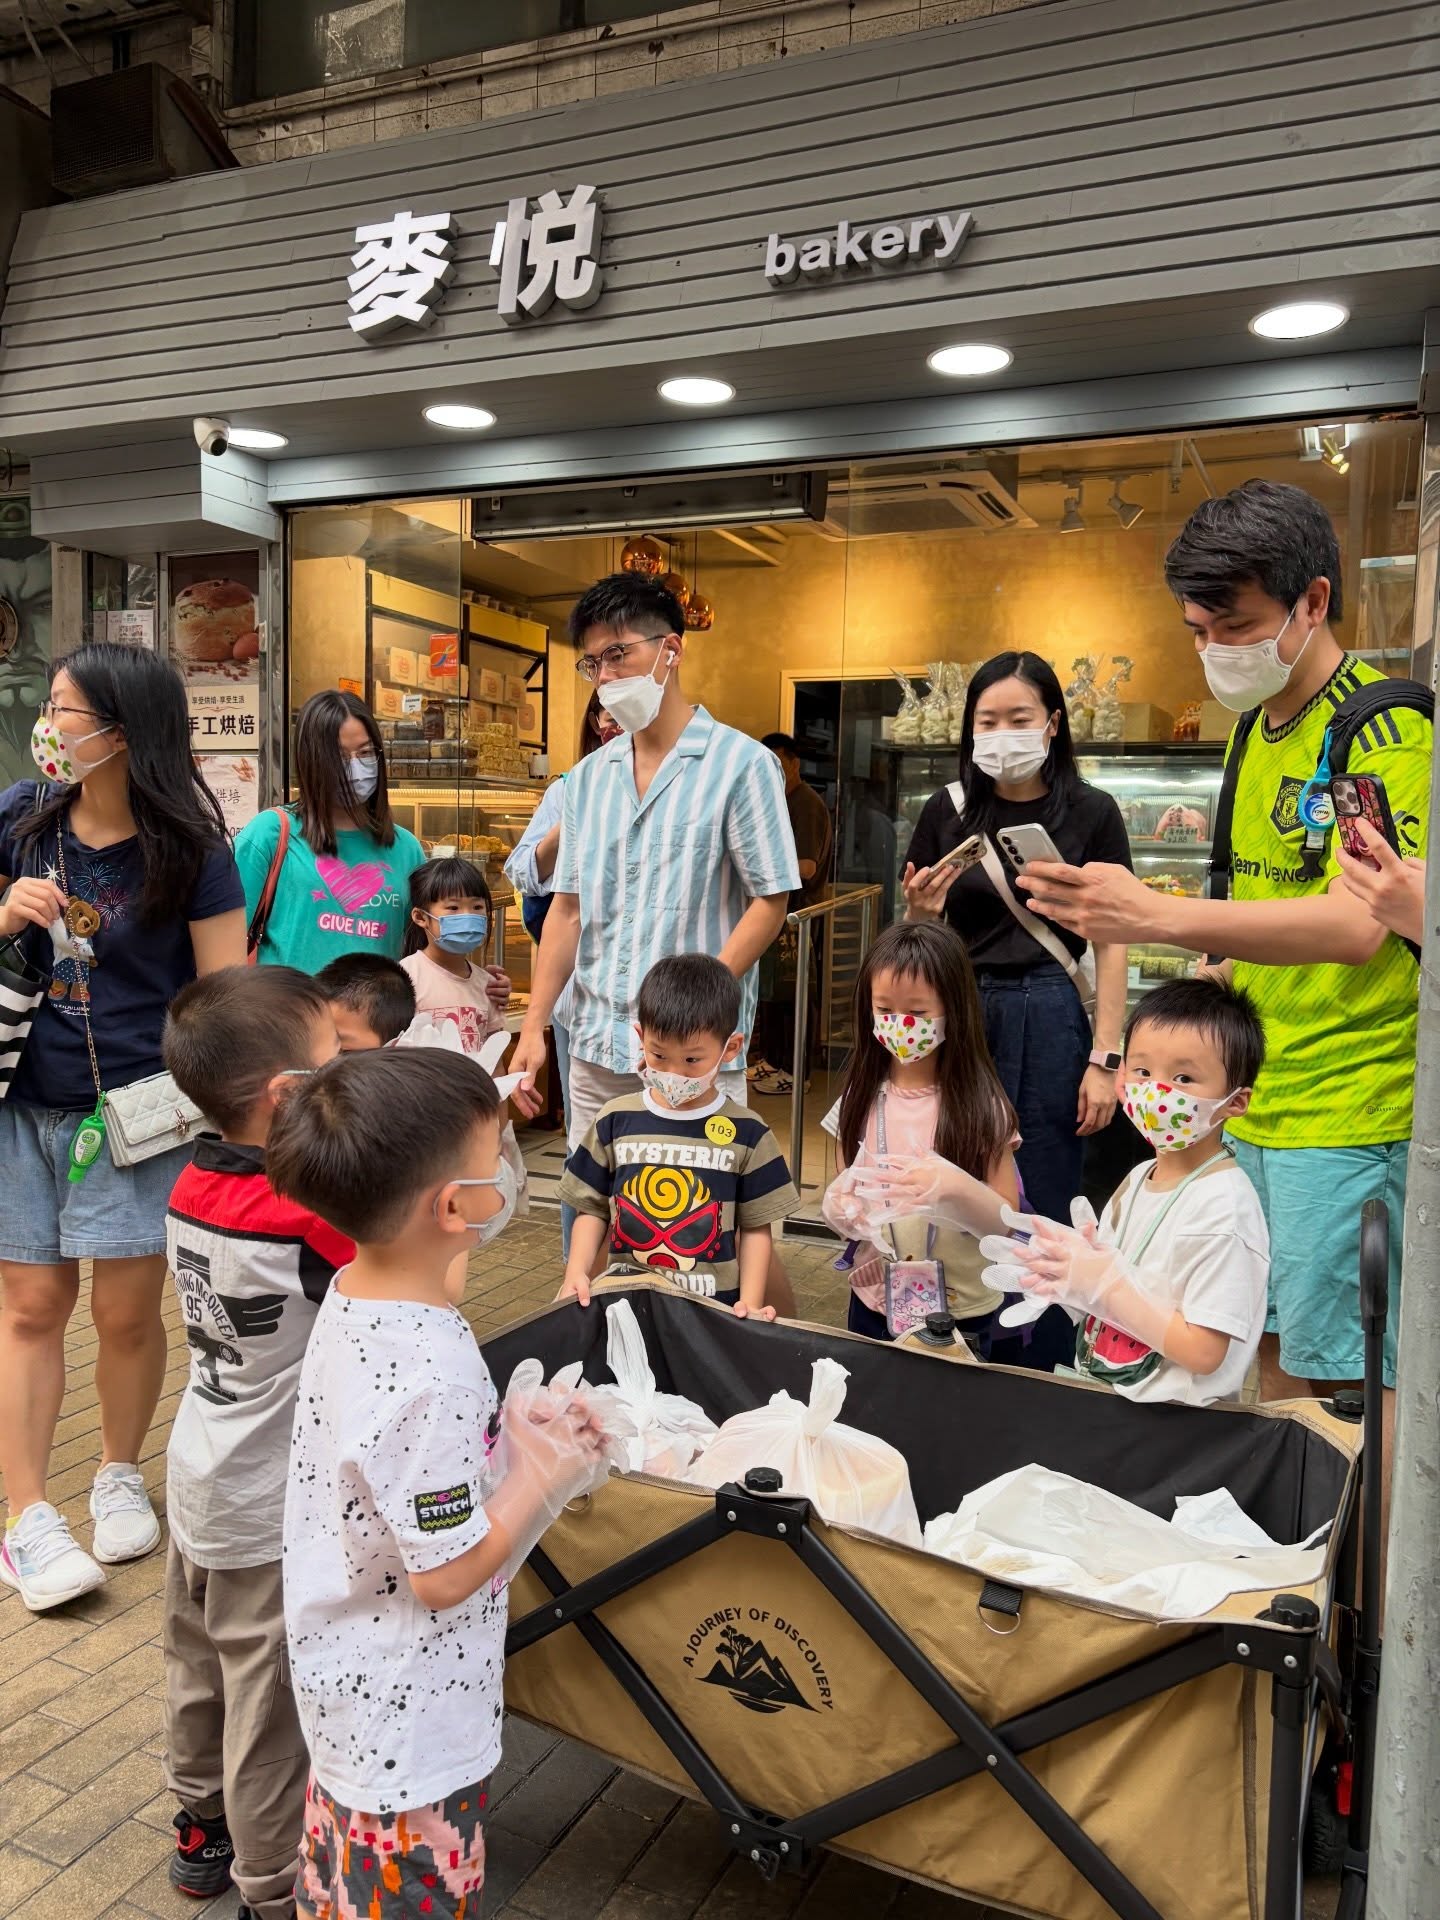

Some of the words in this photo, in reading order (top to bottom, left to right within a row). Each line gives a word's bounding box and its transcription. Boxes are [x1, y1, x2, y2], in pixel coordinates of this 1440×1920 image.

[765, 211, 973, 284] bakery
[187, 714, 255, 736] 手工烘焙
[319, 913, 354, 934] GIVE
[357, 919, 380, 937] ME
[710, 1123, 733, 1138] 103
[616, 1143, 735, 1171] HYSTERIC
[186, 1294, 203, 1323] 95
[419, 1496, 469, 1518] STITCH
[748, 1607, 770, 1623] OF
[686, 1607, 742, 1655] JOURNEY
[682, 1655, 694, 1668] A
[773, 1617, 834, 1711] DISCOVERY
